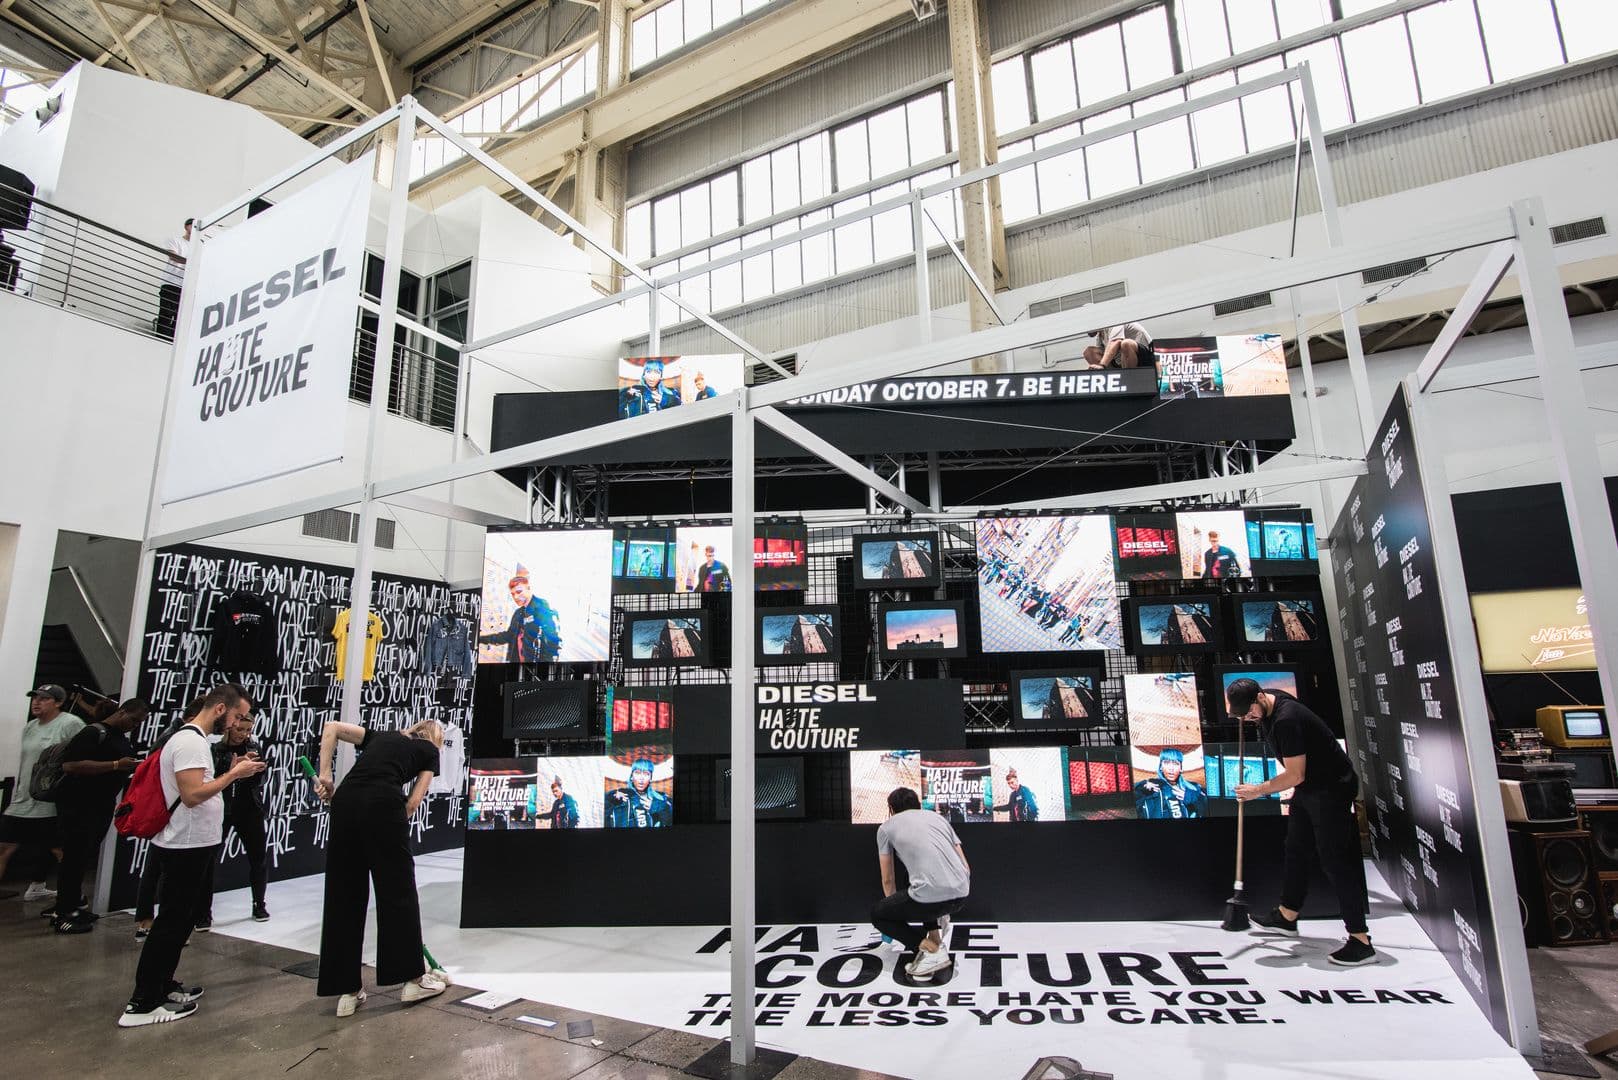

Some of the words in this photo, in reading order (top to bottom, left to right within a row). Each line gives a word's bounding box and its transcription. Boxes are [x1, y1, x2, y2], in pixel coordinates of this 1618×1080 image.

[200, 247, 346, 339] DIESEL
[200, 344, 314, 422] COUTURE
[882, 379, 988, 401] OCTOBER
[996, 378, 1016, 397] 7.
[1022, 376, 1053, 396] BE
[1058, 373, 1128, 394] HERE.
[754, 552, 798, 560] DIESEL
[1122, 541, 1168, 549] DIESEL
[156, 552, 188, 586] THE
[184, 554, 225, 590] MORE
[260, 564, 289, 597] YOU
[288, 560, 329, 604] WEAR
[326, 575, 351, 604] THE
[377, 578, 403, 612] HATE
[400, 583, 423, 612] YOU
[422, 583, 454, 616] WEAR
[452, 591, 470, 617] THE
[158, 588, 193, 629] THE
[277, 600, 318, 639] CARE
[392, 610, 417, 642] YOU
[145, 631, 178, 666] THE
[281, 637, 322, 673] WEAR
[374, 640, 399, 675] HATE
[1417, 661, 1440, 679] DIESEL
[147, 668, 183, 709] THE
[269, 671, 309, 709] CARE
[387, 671, 412, 706] YOU
[411, 674, 442, 708] CARE
[452, 676, 472, 706] THE
[758, 684, 877, 704] DIESEL
[275, 707, 316, 744] WEAR
[1400, 721, 1420, 738] DIESEL
[770, 727, 860, 750] COUTURE
[480, 787, 531, 801] COUTURE
[934, 779, 985, 794] COUTURE
[408, 798, 434, 843] ARE
[445, 796, 465, 828] THE
[816, 992, 977, 1008] MORE
[998, 991, 1137, 1006] HATE
[1149, 990, 1267, 1006] YOU
[1277, 989, 1456, 1005] WEAR
[806, 1009, 949, 1027] LESS
[968, 1008, 1085, 1026] YOU
[1107, 1007, 1288, 1026] CARE.
